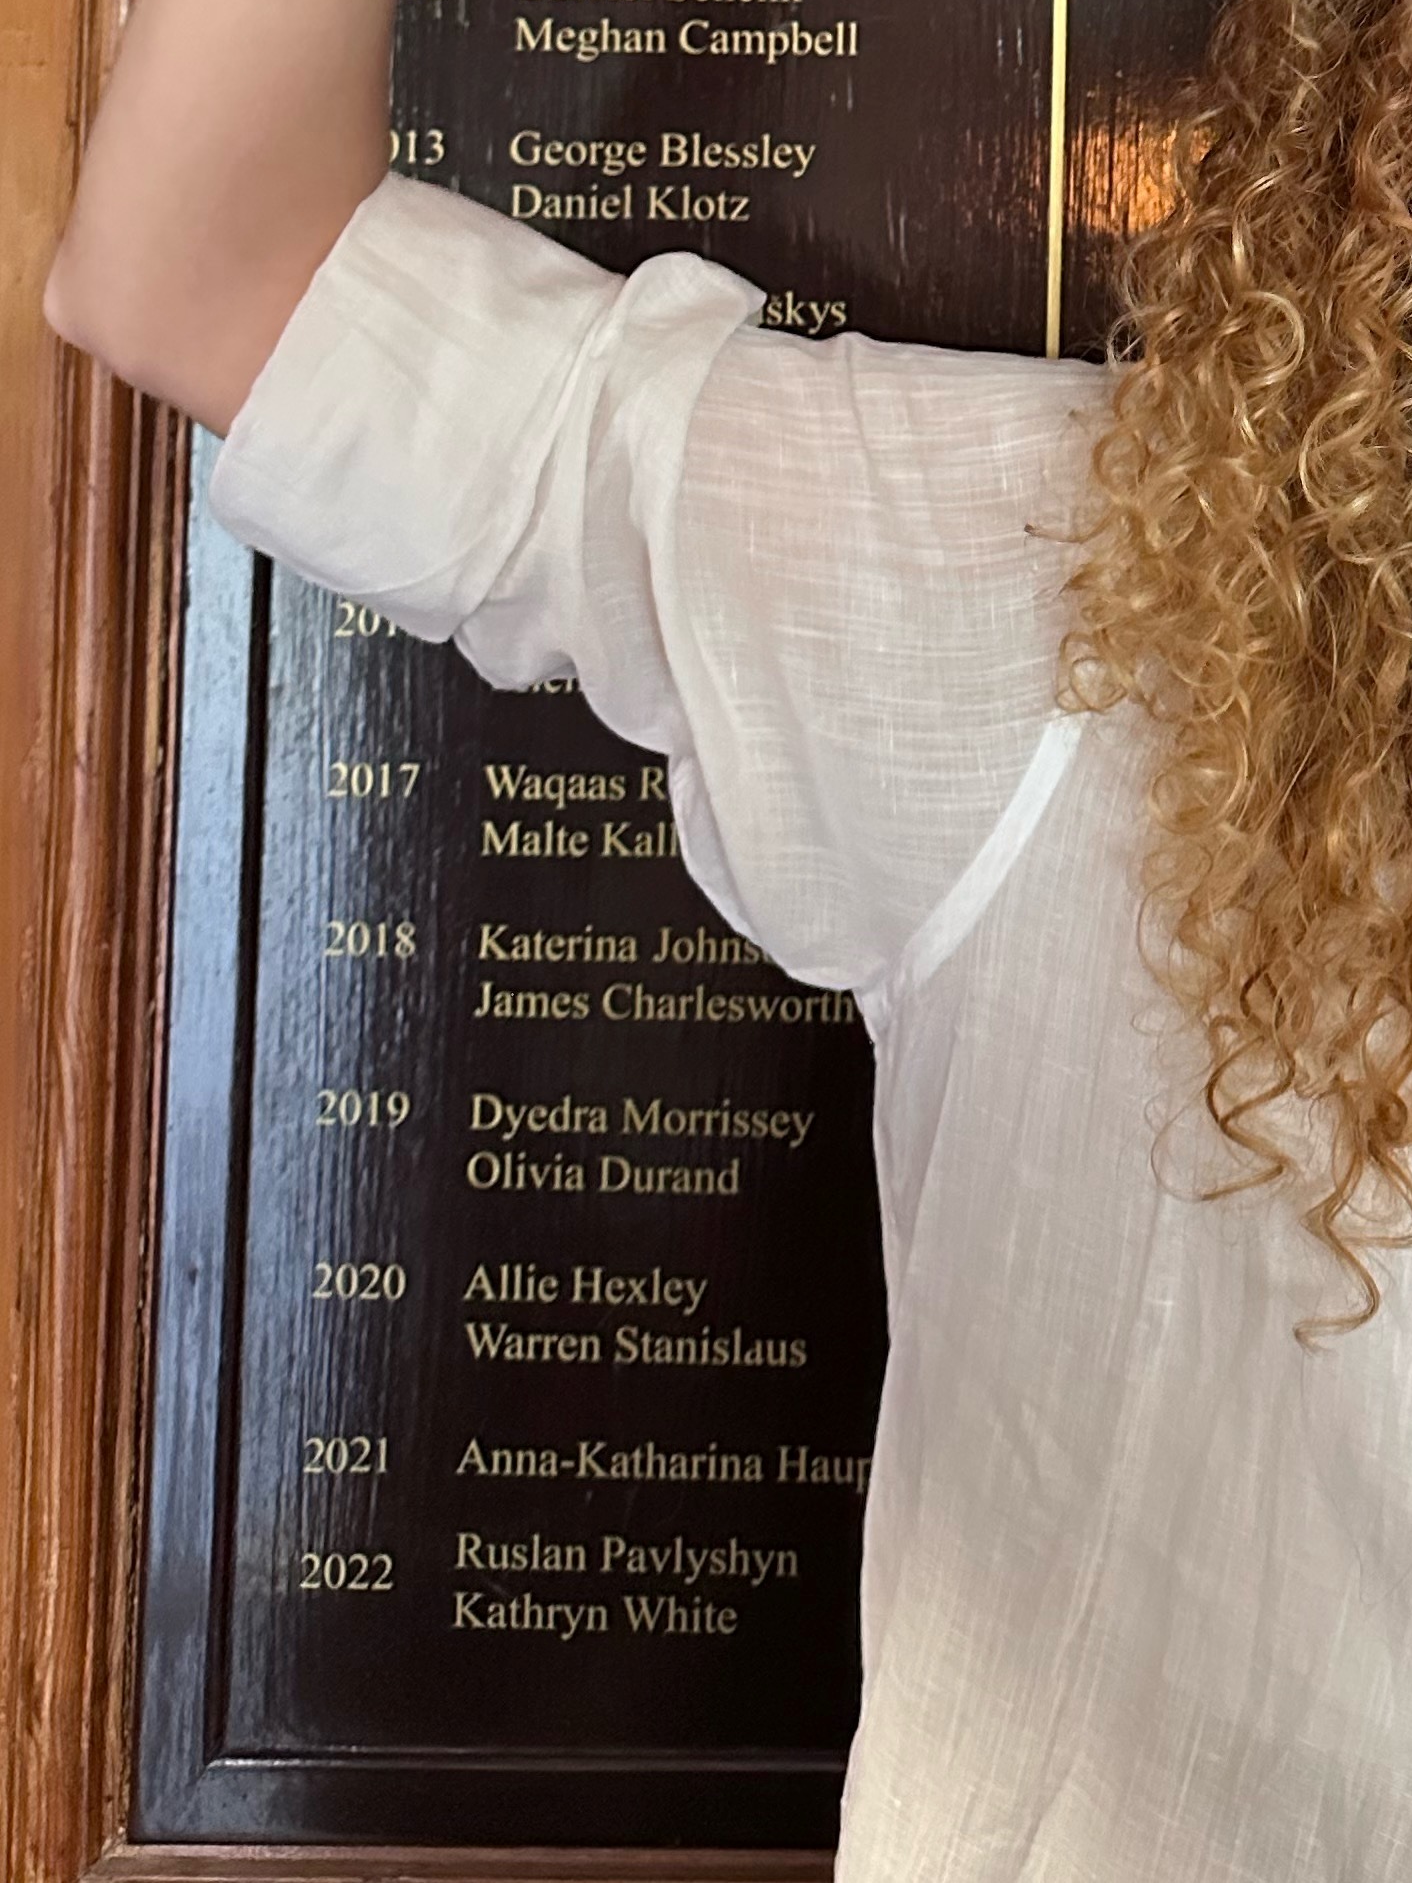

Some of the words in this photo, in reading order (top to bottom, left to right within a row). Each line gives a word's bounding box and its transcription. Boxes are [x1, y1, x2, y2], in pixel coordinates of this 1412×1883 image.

[516, 17, 666, 62] Meghan
[679, 20, 857, 65] Campbell
[509, 130, 647, 176] George
[661, 133, 816, 178] Blessley
[511, 184, 632, 220] Daniel
[648, 185, 749, 221] Klotz
[757, 289, 848, 335] škys
[327, 762, 420, 799] 2017
[485, 764, 626, 810] Waqaas
[482, 820, 588, 857] Malte
[323, 921, 417, 958] 2018
[478, 924, 637, 962] Katerina
[474, 981, 590, 1019] James
[602, 982, 856, 1022] Charlesworth
[315, 1090, 410, 1127] 2019
[471, 1093, 607, 1141] Dyedra
[622, 1097, 813, 1148] Morrissey
[466, 1151, 584, 1191] Olivia
[599, 1155, 739, 1194] Durand
[312, 1263, 407, 1301] 2020
[463, 1264, 558, 1303] Allie
[572, 1266, 707, 1315] Hexley
[465, 1322, 600, 1362] Warren
[614, 1325, 806, 1366] Stanislaus
[303, 1436, 387, 1475] 2021
[456, 1438, 762, 1481] Anna-Katharina
[299, 1551, 393, 1590] 2022
[456, 1533, 586, 1571] Ruslan
[600, 1535, 797, 1586] Pavlyshyn
[453, 1591, 607, 1641] Kathryn
[623, 1595, 737, 1634] White
